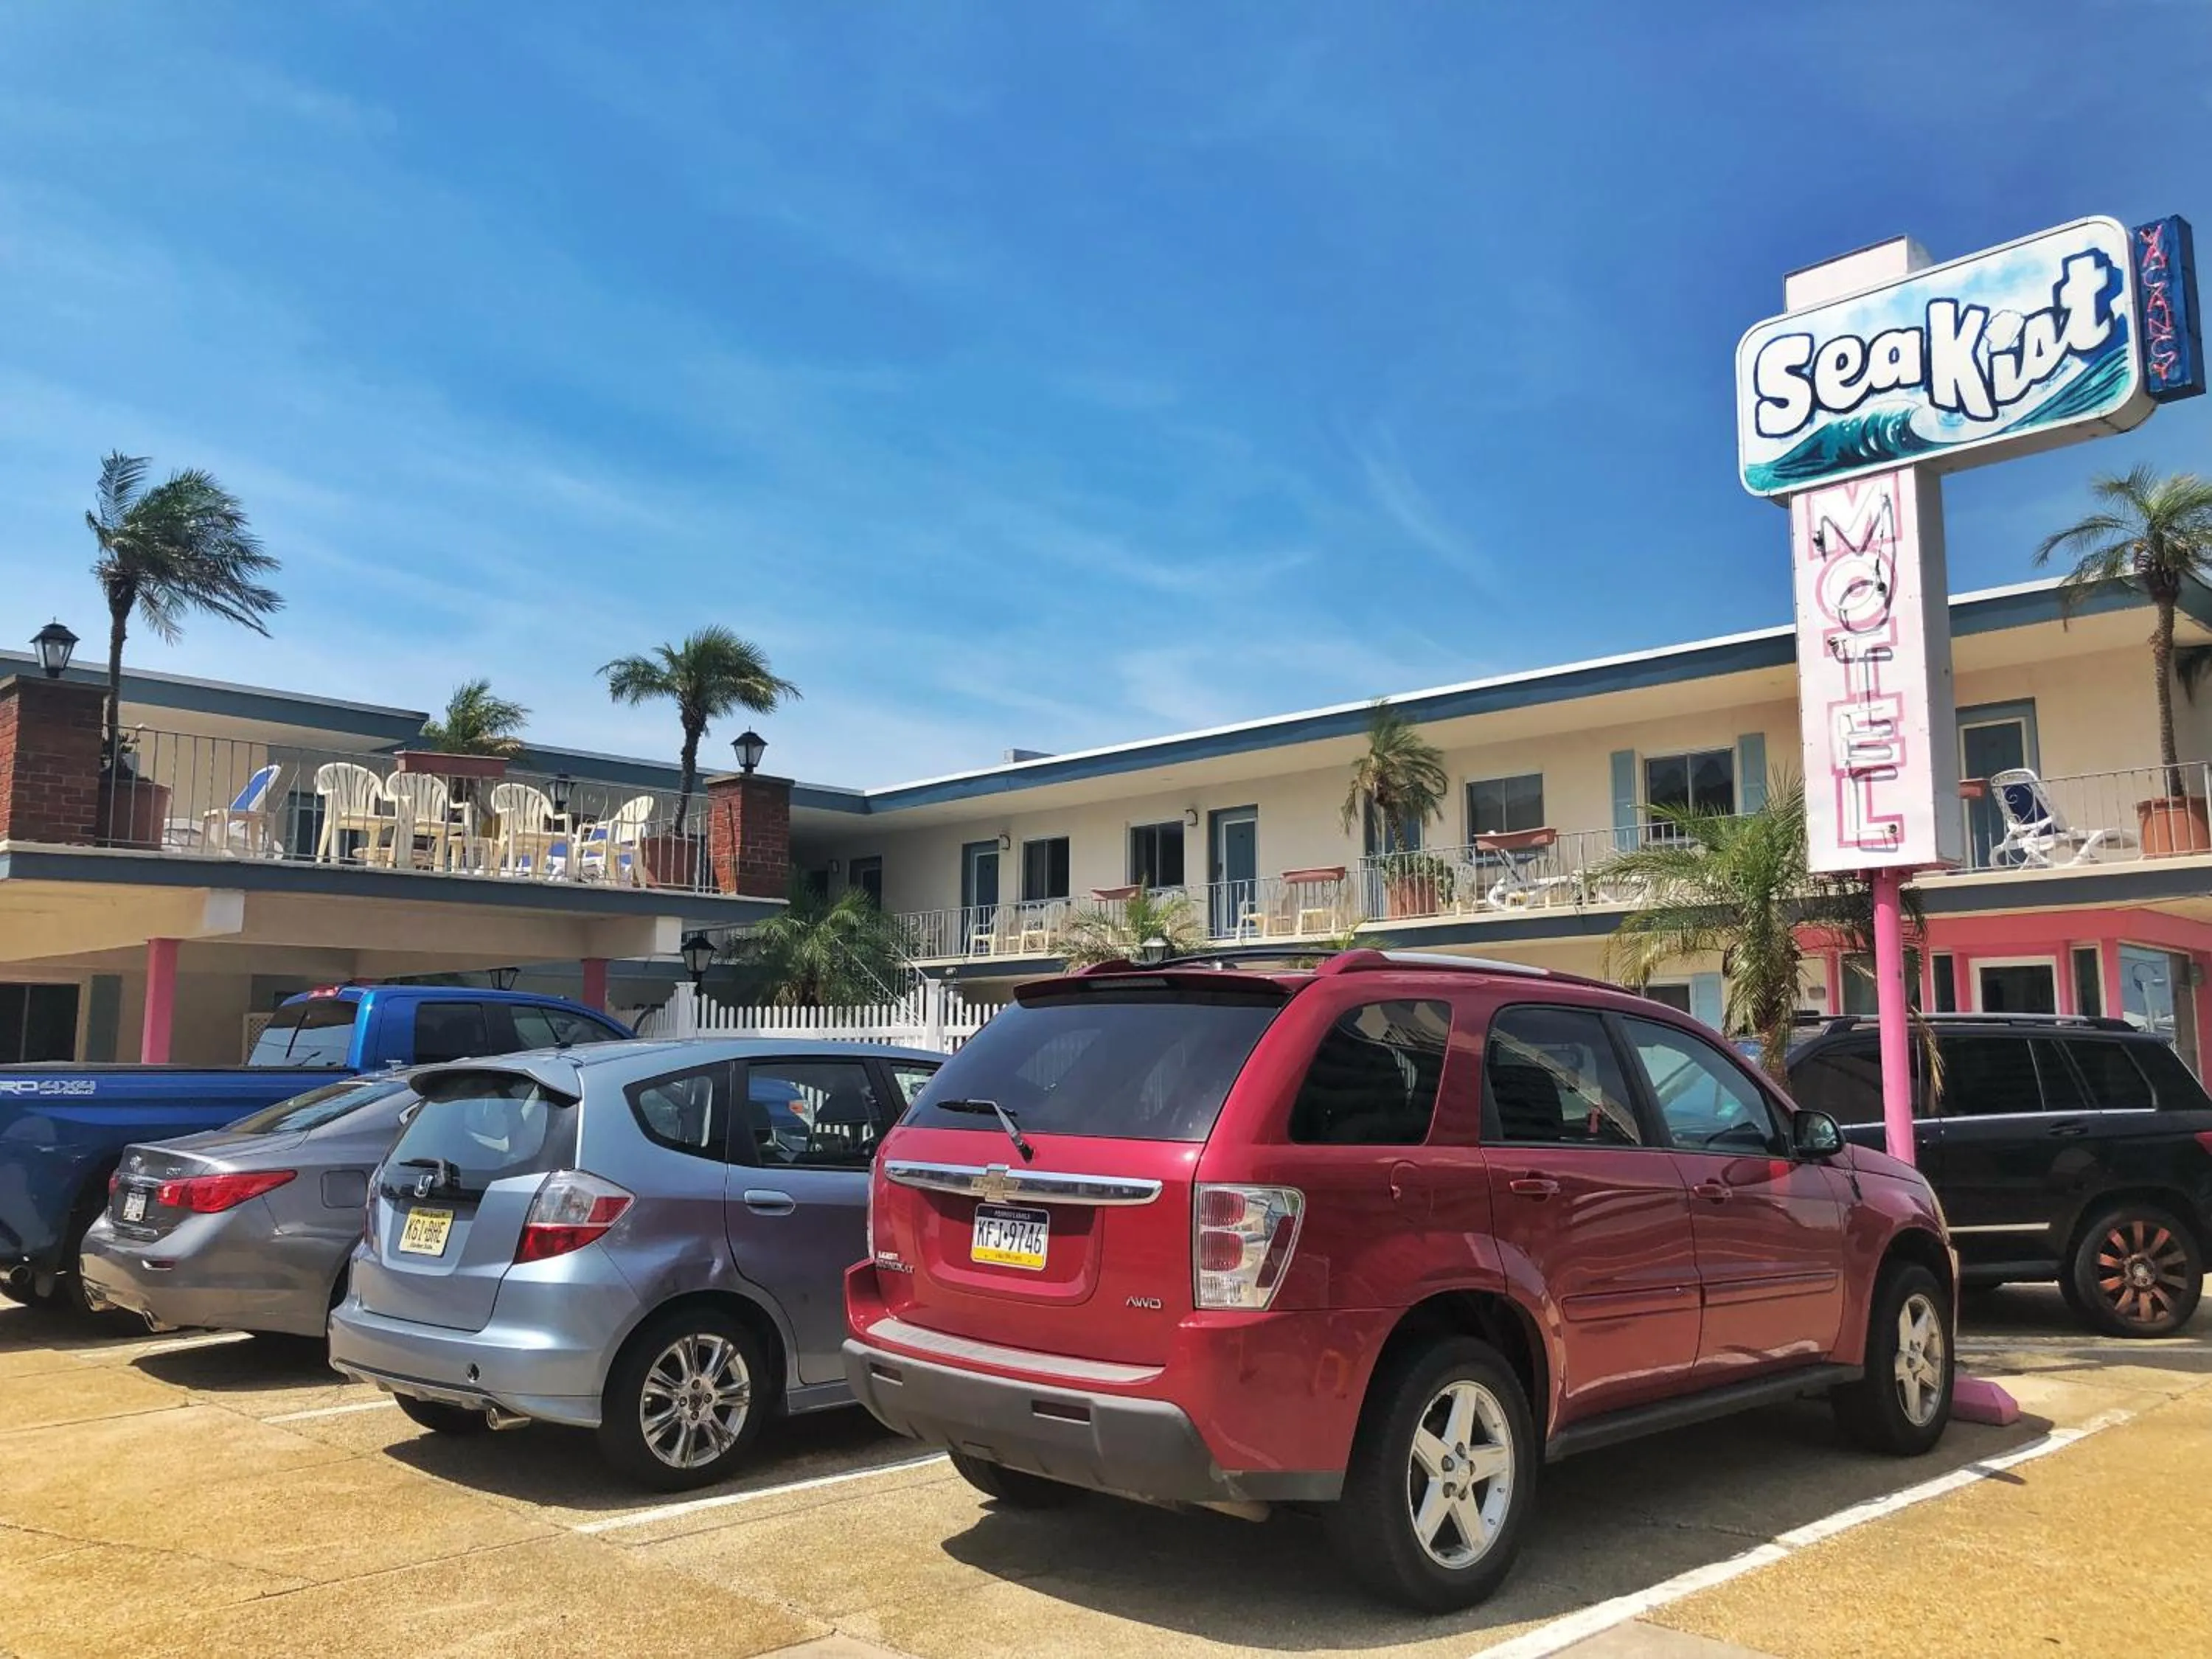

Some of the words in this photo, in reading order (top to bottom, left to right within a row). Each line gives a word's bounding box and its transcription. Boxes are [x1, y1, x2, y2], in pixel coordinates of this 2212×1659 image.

[2140, 223, 2176, 380] VACANCY
[1806, 471, 1904, 852] MOTEL
[1126, 1295, 1161, 1309] AWD
